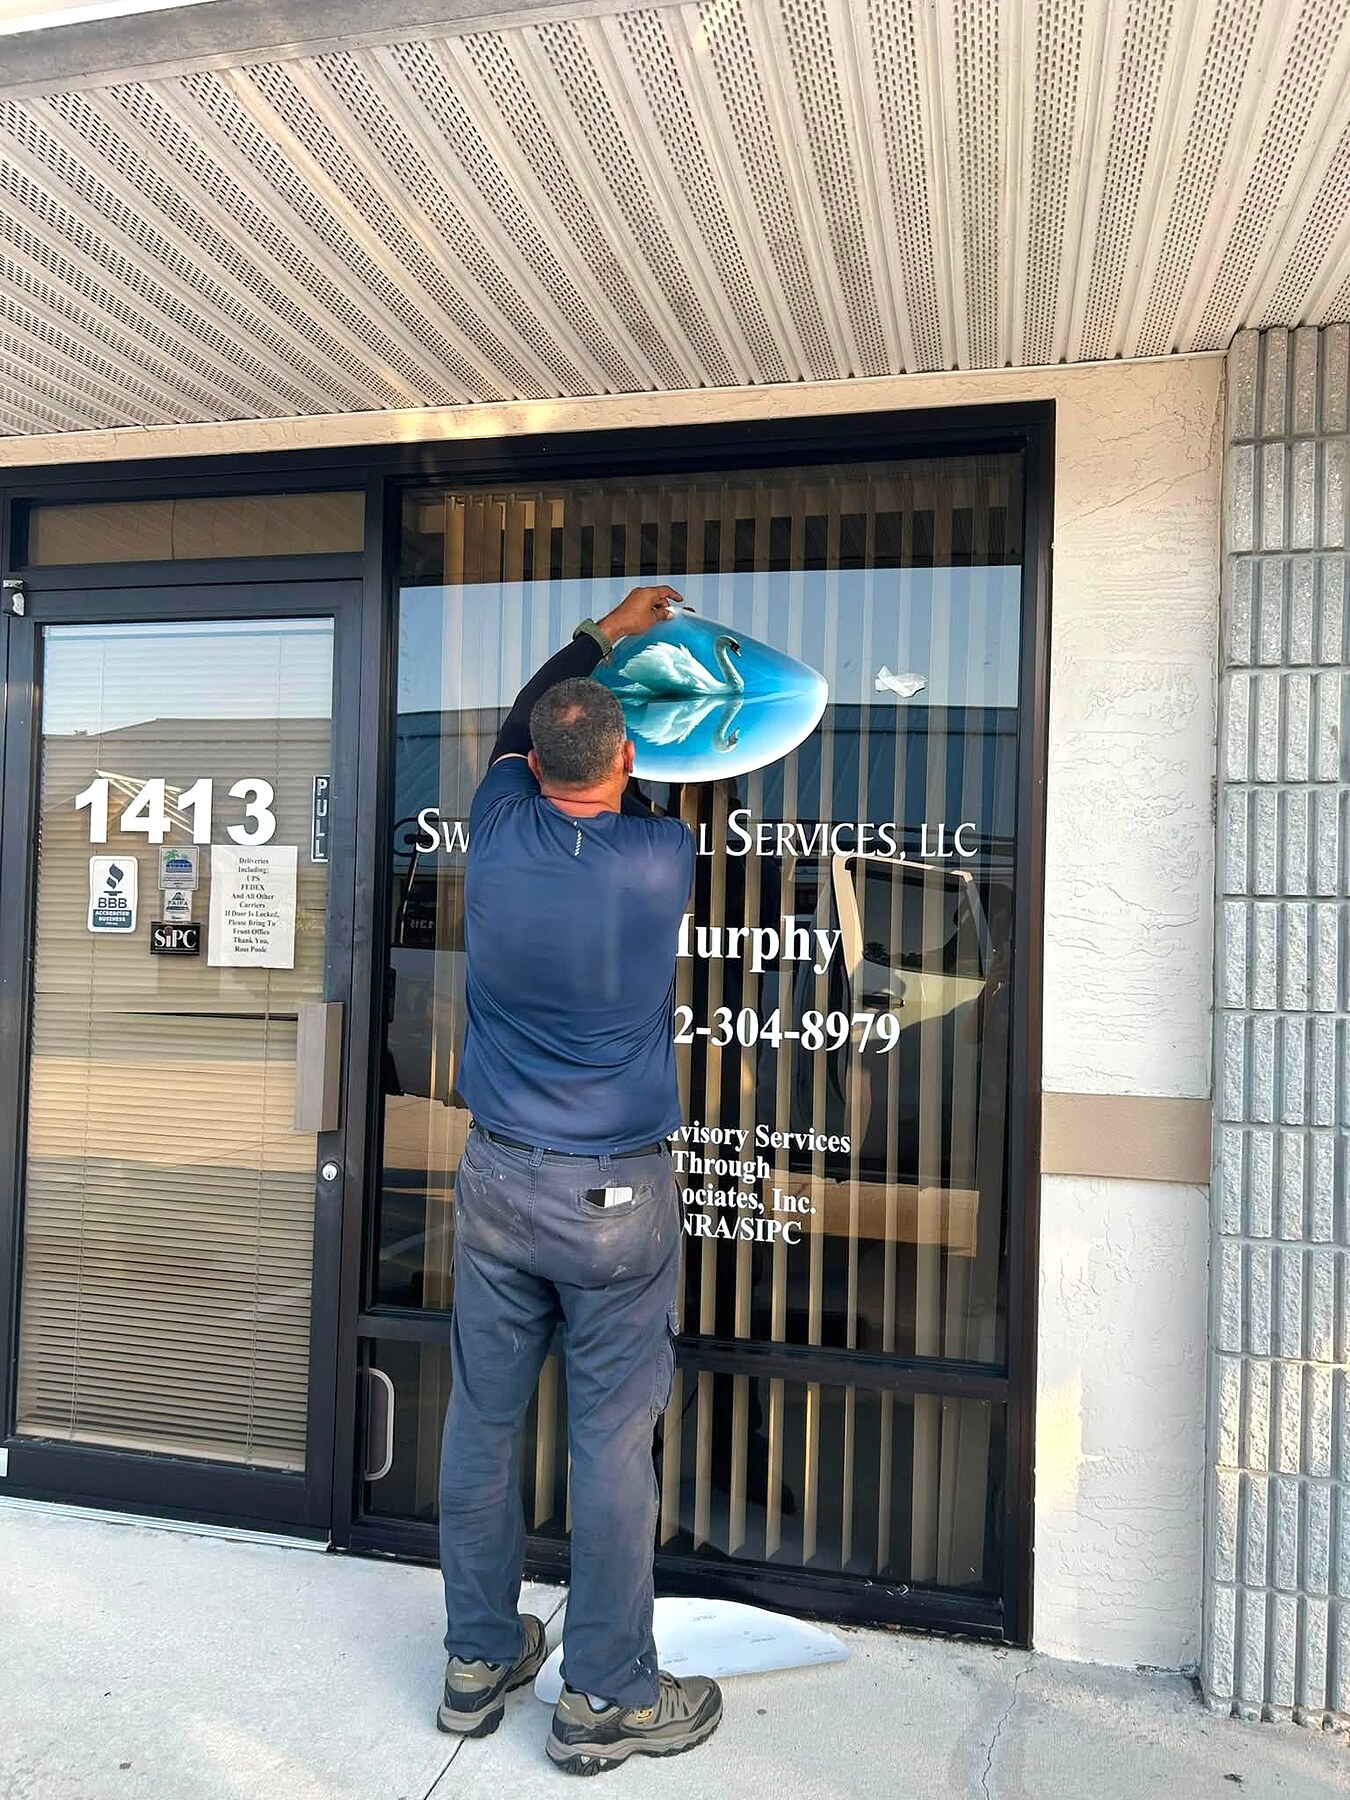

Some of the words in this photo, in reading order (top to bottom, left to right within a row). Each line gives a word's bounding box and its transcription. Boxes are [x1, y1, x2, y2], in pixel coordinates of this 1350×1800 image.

[75, 778, 277, 845] 1413
[315, 779, 328, 857] PULL
[726, 809, 906, 860] SERVICES,
[921, 822, 977, 857] LLC
[98, 898, 127, 908] BBB
[674, 1004, 900, 1054] 2-304-8979
[667, 1120, 750, 1151] visory
[755, 1124, 851, 1153] Services
[672, 1150, 770, 1184] Through
[682, 1185, 764, 1214] ociates,
[772, 1189, 816, 1214] Inc.
[683, 1213, 802, 1245] NRA/SIPC
